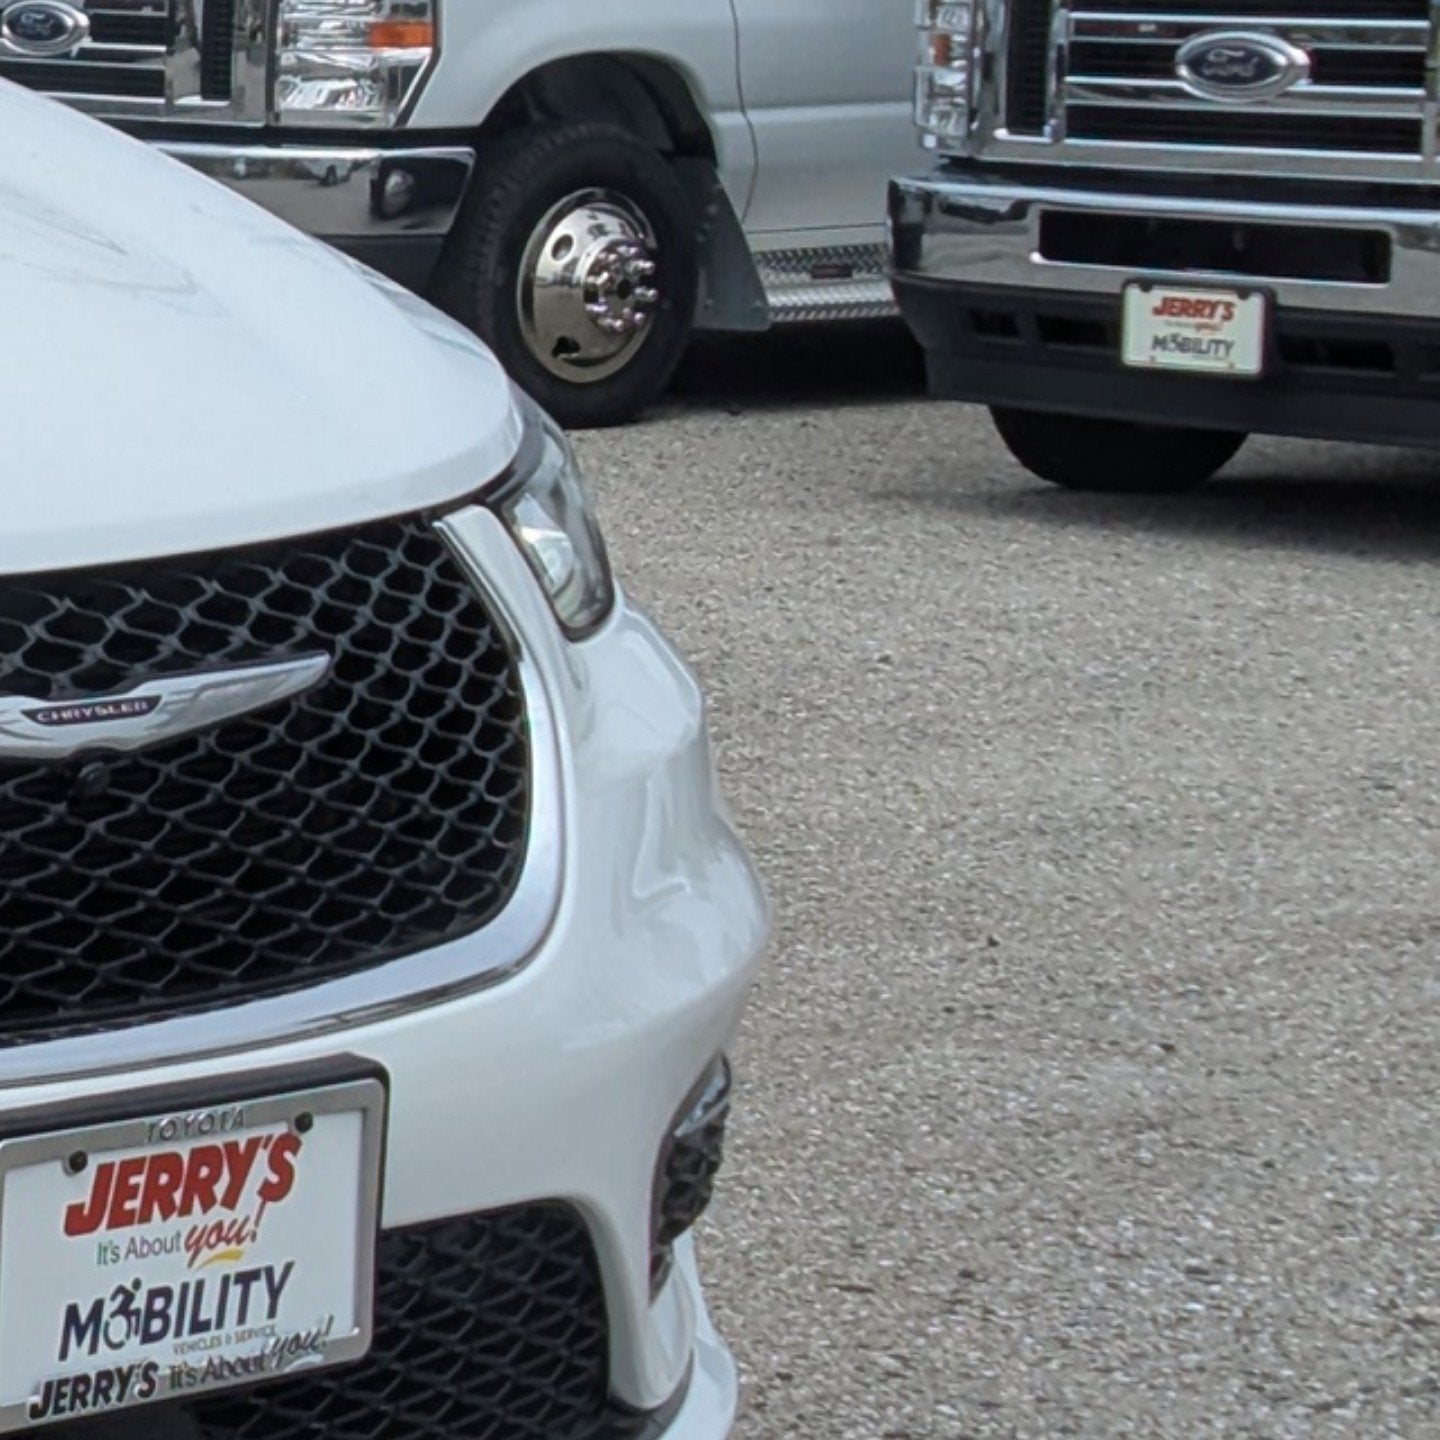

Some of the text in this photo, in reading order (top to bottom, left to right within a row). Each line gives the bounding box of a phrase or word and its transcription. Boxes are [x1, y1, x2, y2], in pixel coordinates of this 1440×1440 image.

[1152, 296, 1236, 321] JERRY'S
[36, 701, 148, 722] CHRYSLER
[145, 1107, 245, 1143] TOYOTA
[64, 1132, 302, 1237] JERRY'S
[96, 1237, 121, 1266] It's
[123, 1234, 182, 1262] About
[199, 1350, 266, 1384] About
[28, 1360, 158, 1420] JERRY'S
